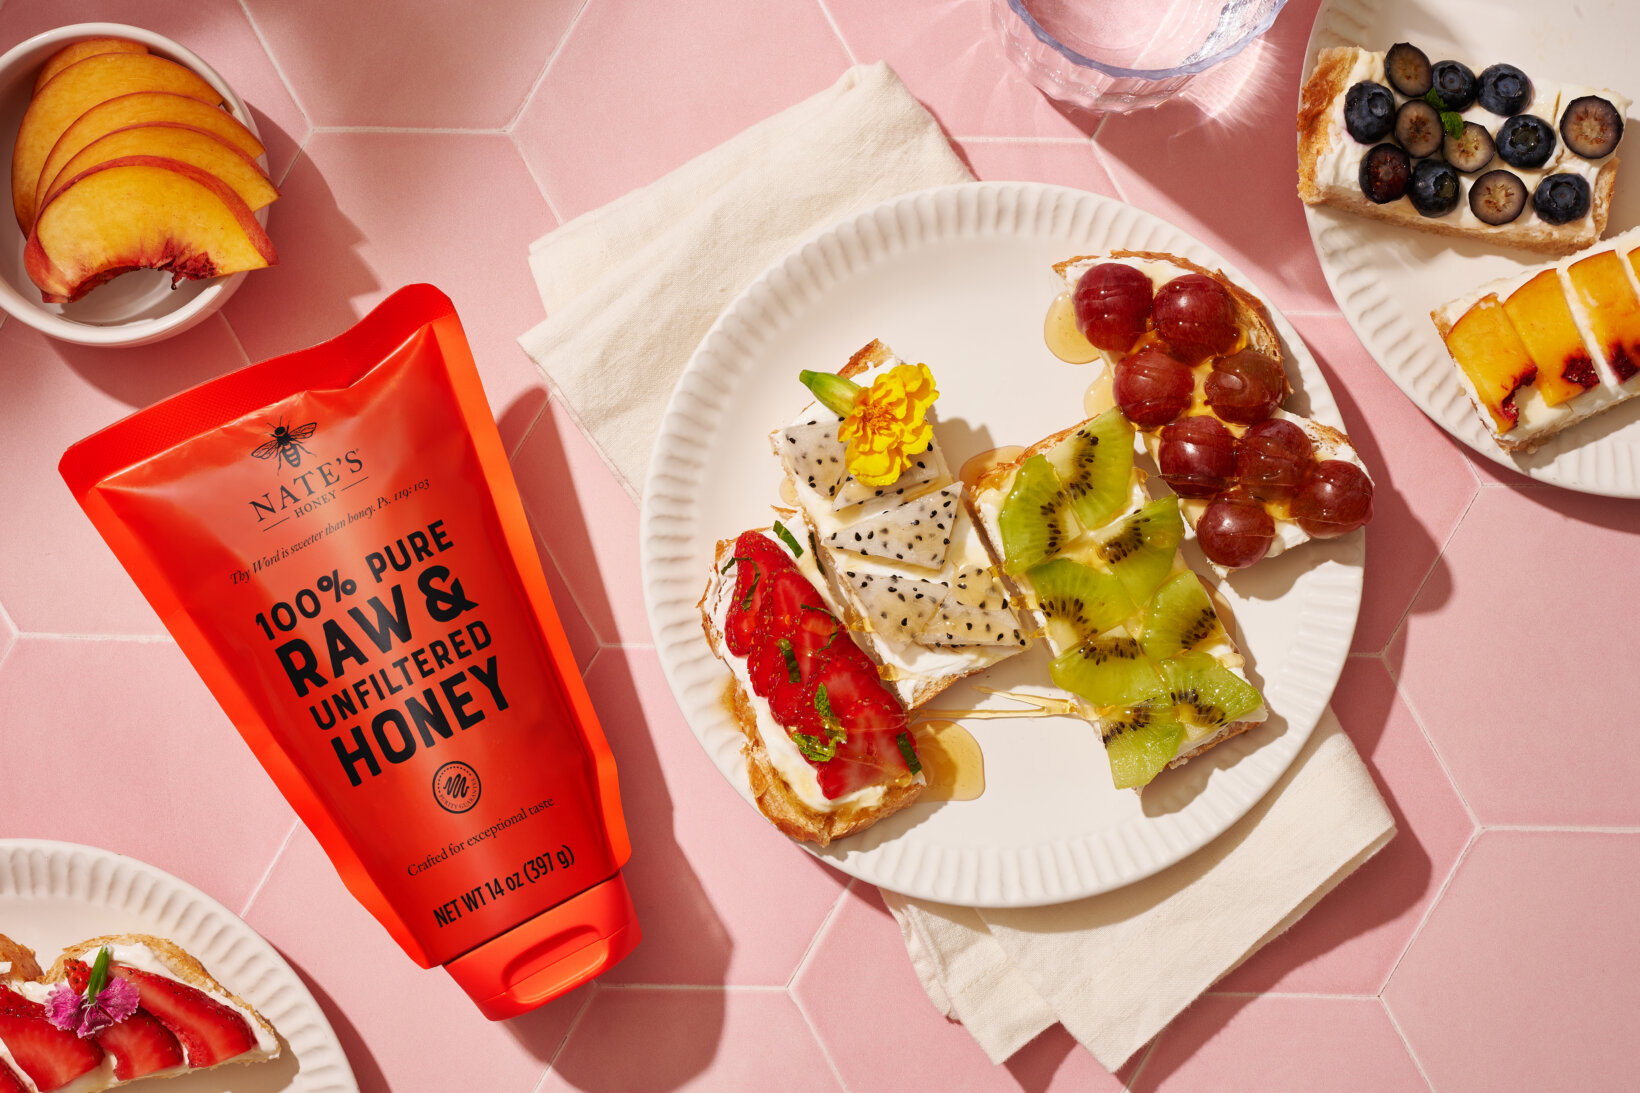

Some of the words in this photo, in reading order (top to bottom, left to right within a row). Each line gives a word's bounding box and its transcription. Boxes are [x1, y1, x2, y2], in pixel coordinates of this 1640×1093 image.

[230, 569, 250, 585] Thy
[253, 549, 280, 574] Word
[281, 547, 290, 559] is
[290, 529, 323, 553] sweeter
[325, 521, 346, 536] than
[347, 505, 376, 524] honey.
[377, 496, 391, 509] Ps.
[293, 489, 337, 519] HONEY
[255, 569, 357, 641] 100%
[365, 519, 454, 583] PURE
[275, 584, 412, 698] RAW
[417, 565, 479, 622] &
[309, 620, 492, 730] UNFILTERED
[330, 655, 509, 788] HONEY
[407, 848, 449, 877] Crafted
[448, 842, 465, 856] for
[466, 808, 527, 846] exceptional
[528, 797, 555, 815] taste
[433, 899, 462, 928] NET
[461, 886, 486, 913] WT
[485, 878, 504, 900] 14
[505, 872, 524, 891] oz
[523, 852, 555, 883] (397
[556, 844, 575, 869] g)
